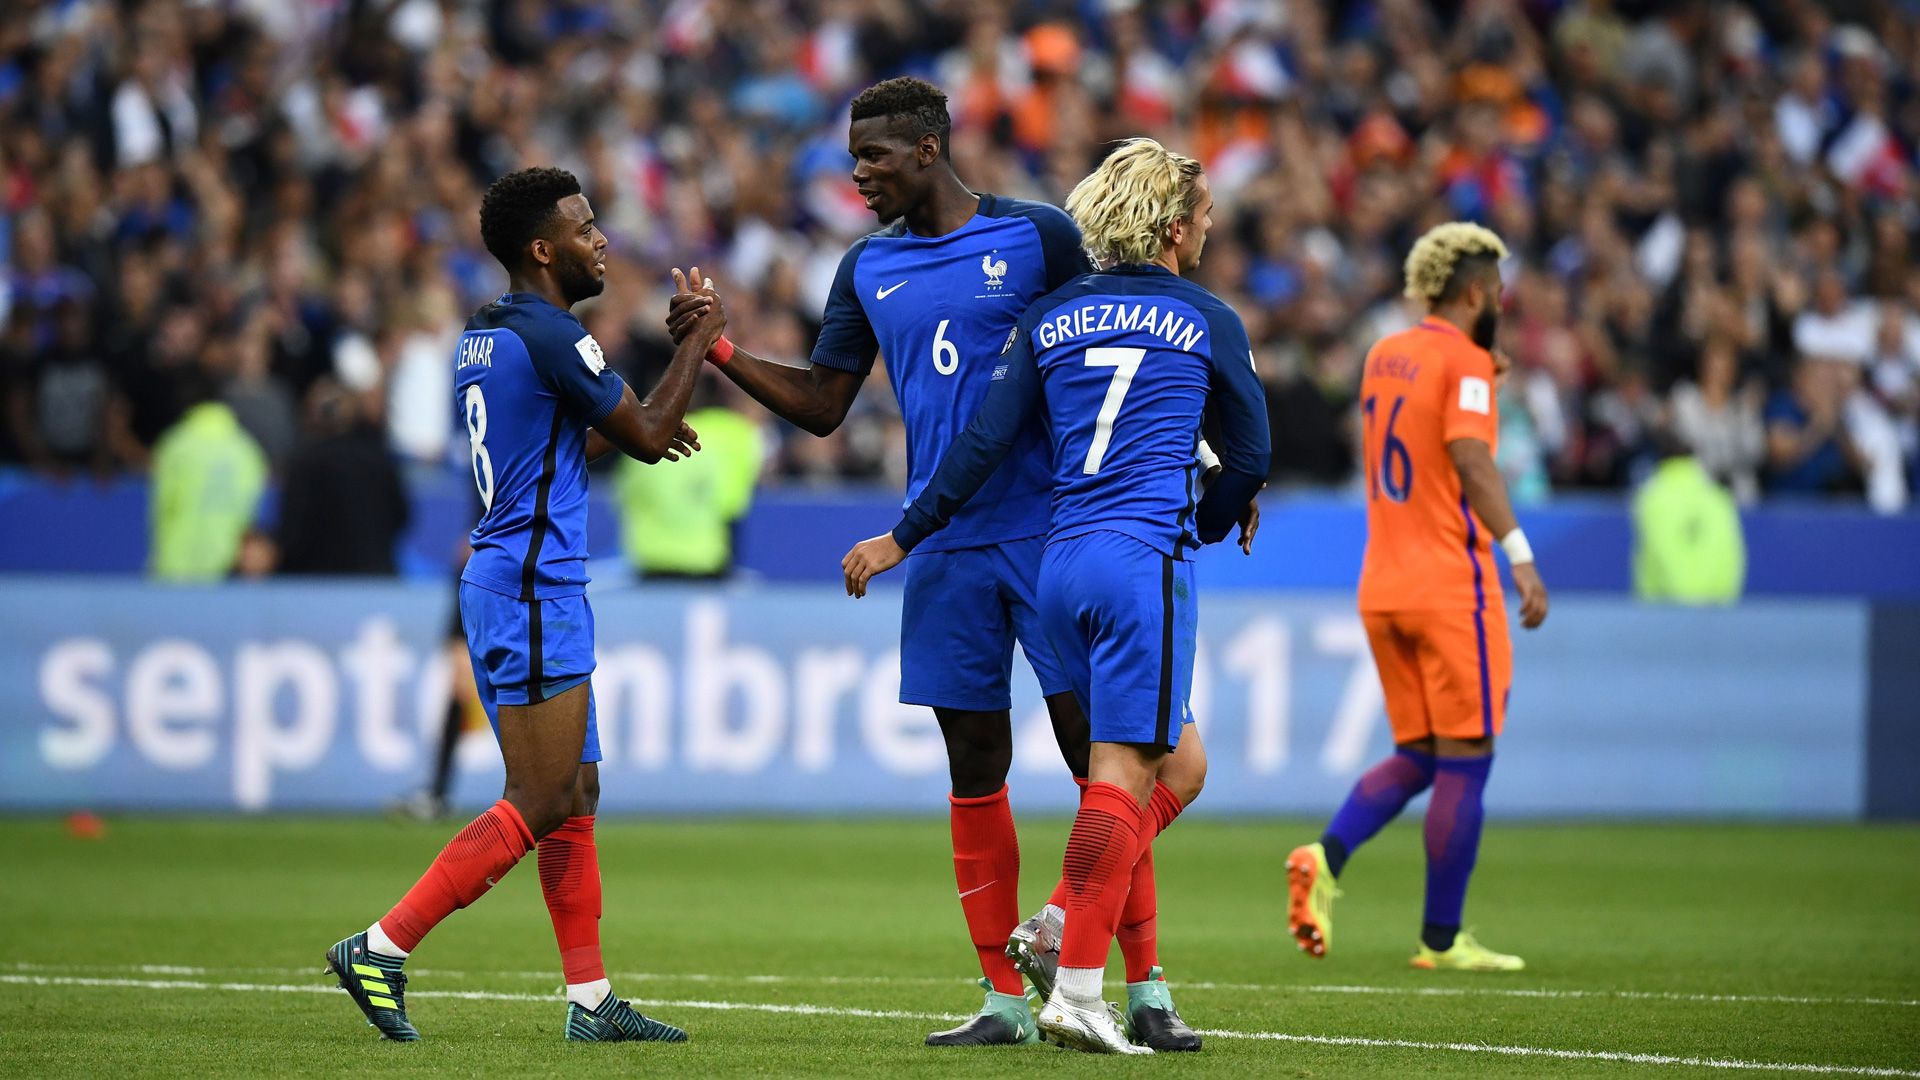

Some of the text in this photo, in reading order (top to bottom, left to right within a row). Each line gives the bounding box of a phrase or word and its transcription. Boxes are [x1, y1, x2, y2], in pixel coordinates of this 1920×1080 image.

[457, 335, 494, 371] LEMAR
[932, 319, 959, 376] 6
[1039, 304, 1204, 352] GRIEZMANN
[465, 384, 494, 512] 8
[1083, 347, 1147, 475] 7
[1365, 393, 1414, 503] 16
